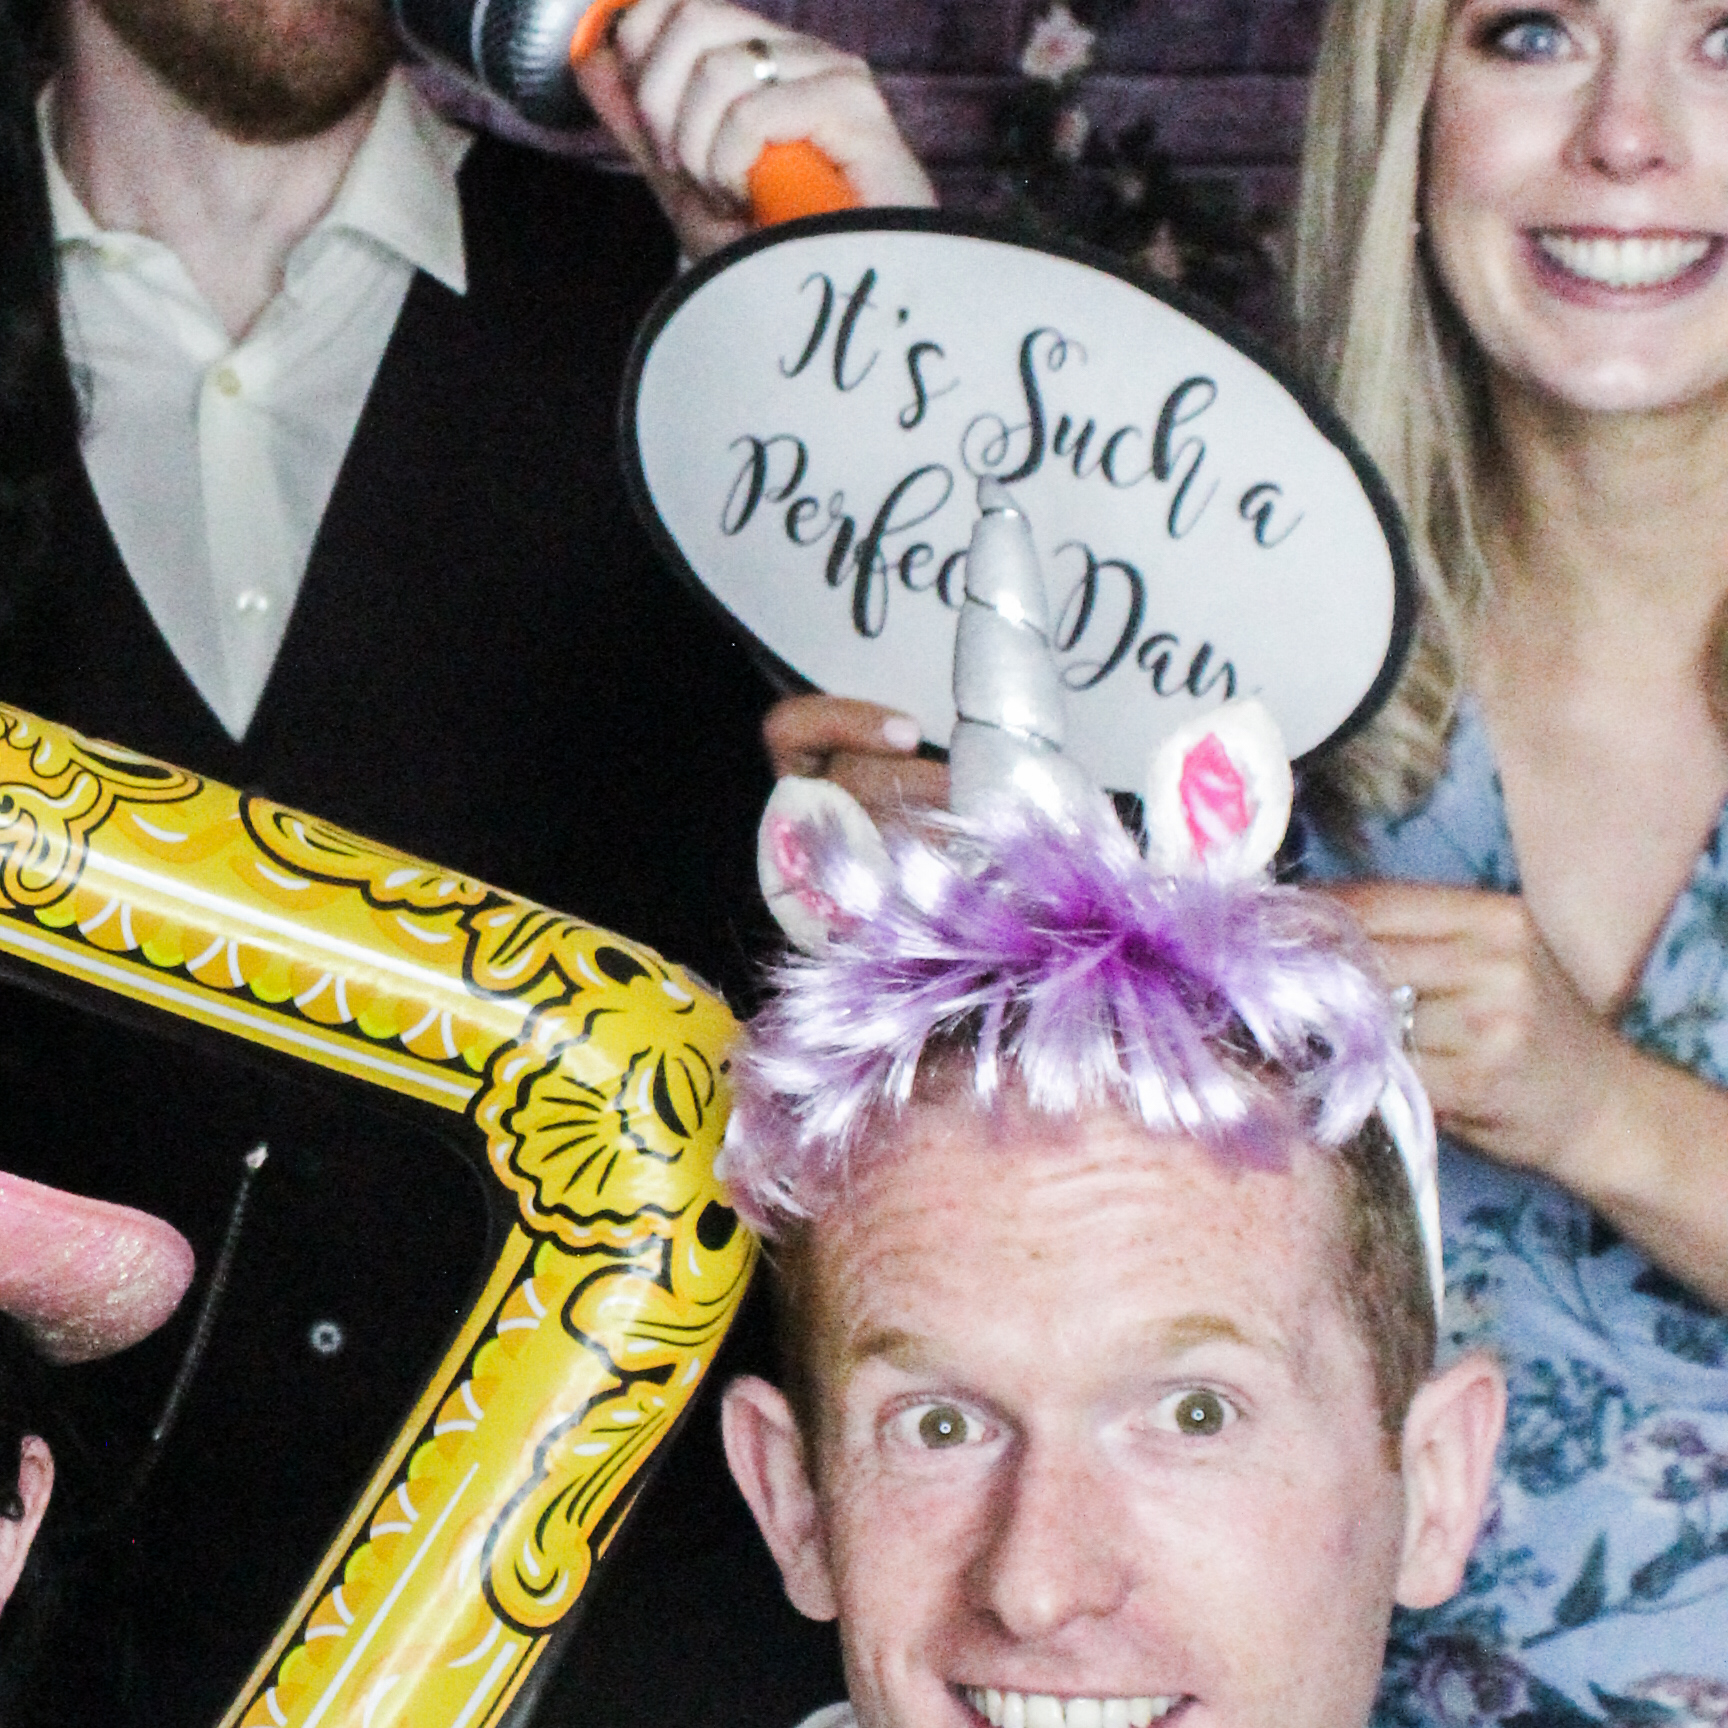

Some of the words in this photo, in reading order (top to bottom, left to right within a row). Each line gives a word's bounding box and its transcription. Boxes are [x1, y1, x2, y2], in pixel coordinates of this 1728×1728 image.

[779, 268, 959, 430] It's
[960, 325, 1219, 538] Such
[1239, 482, 1303, 548] a
[722, 433, 969, 637] Perfec
